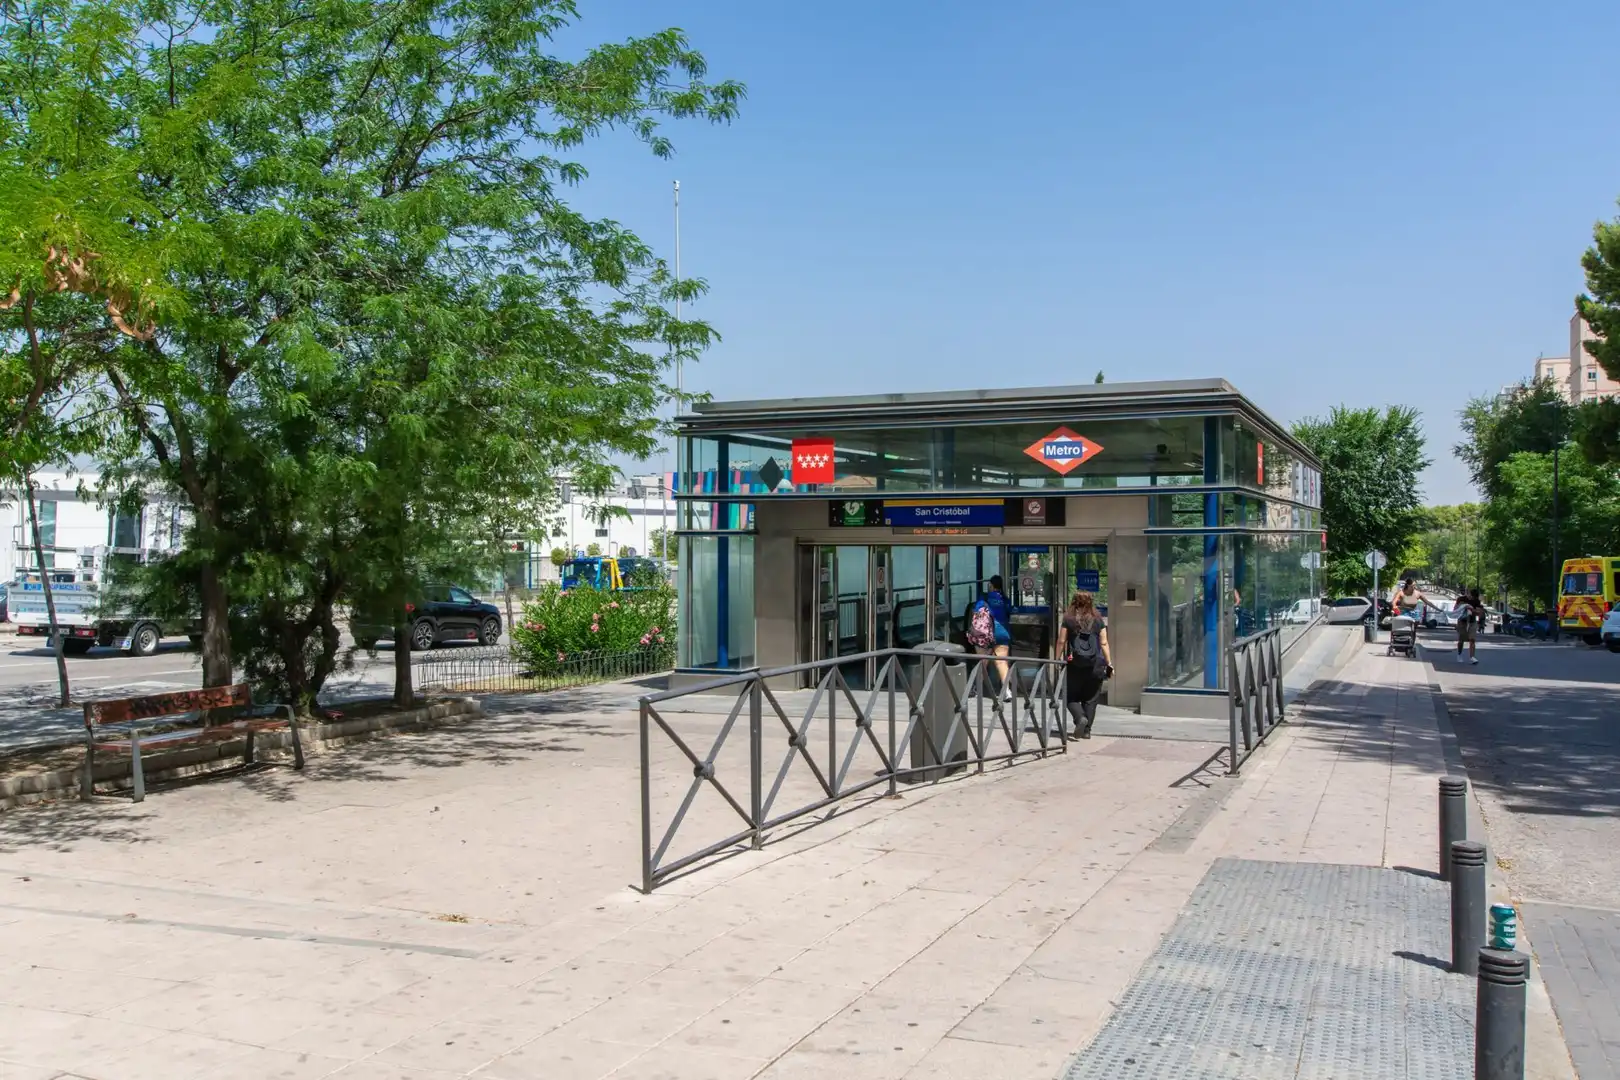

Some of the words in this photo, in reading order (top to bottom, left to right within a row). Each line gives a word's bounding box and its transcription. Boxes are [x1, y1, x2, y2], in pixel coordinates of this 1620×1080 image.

[1045, 445, 1081, 456] Metro
[914, 507, 931, 516] San
[932, 506, 970, 516] Cristóbal
